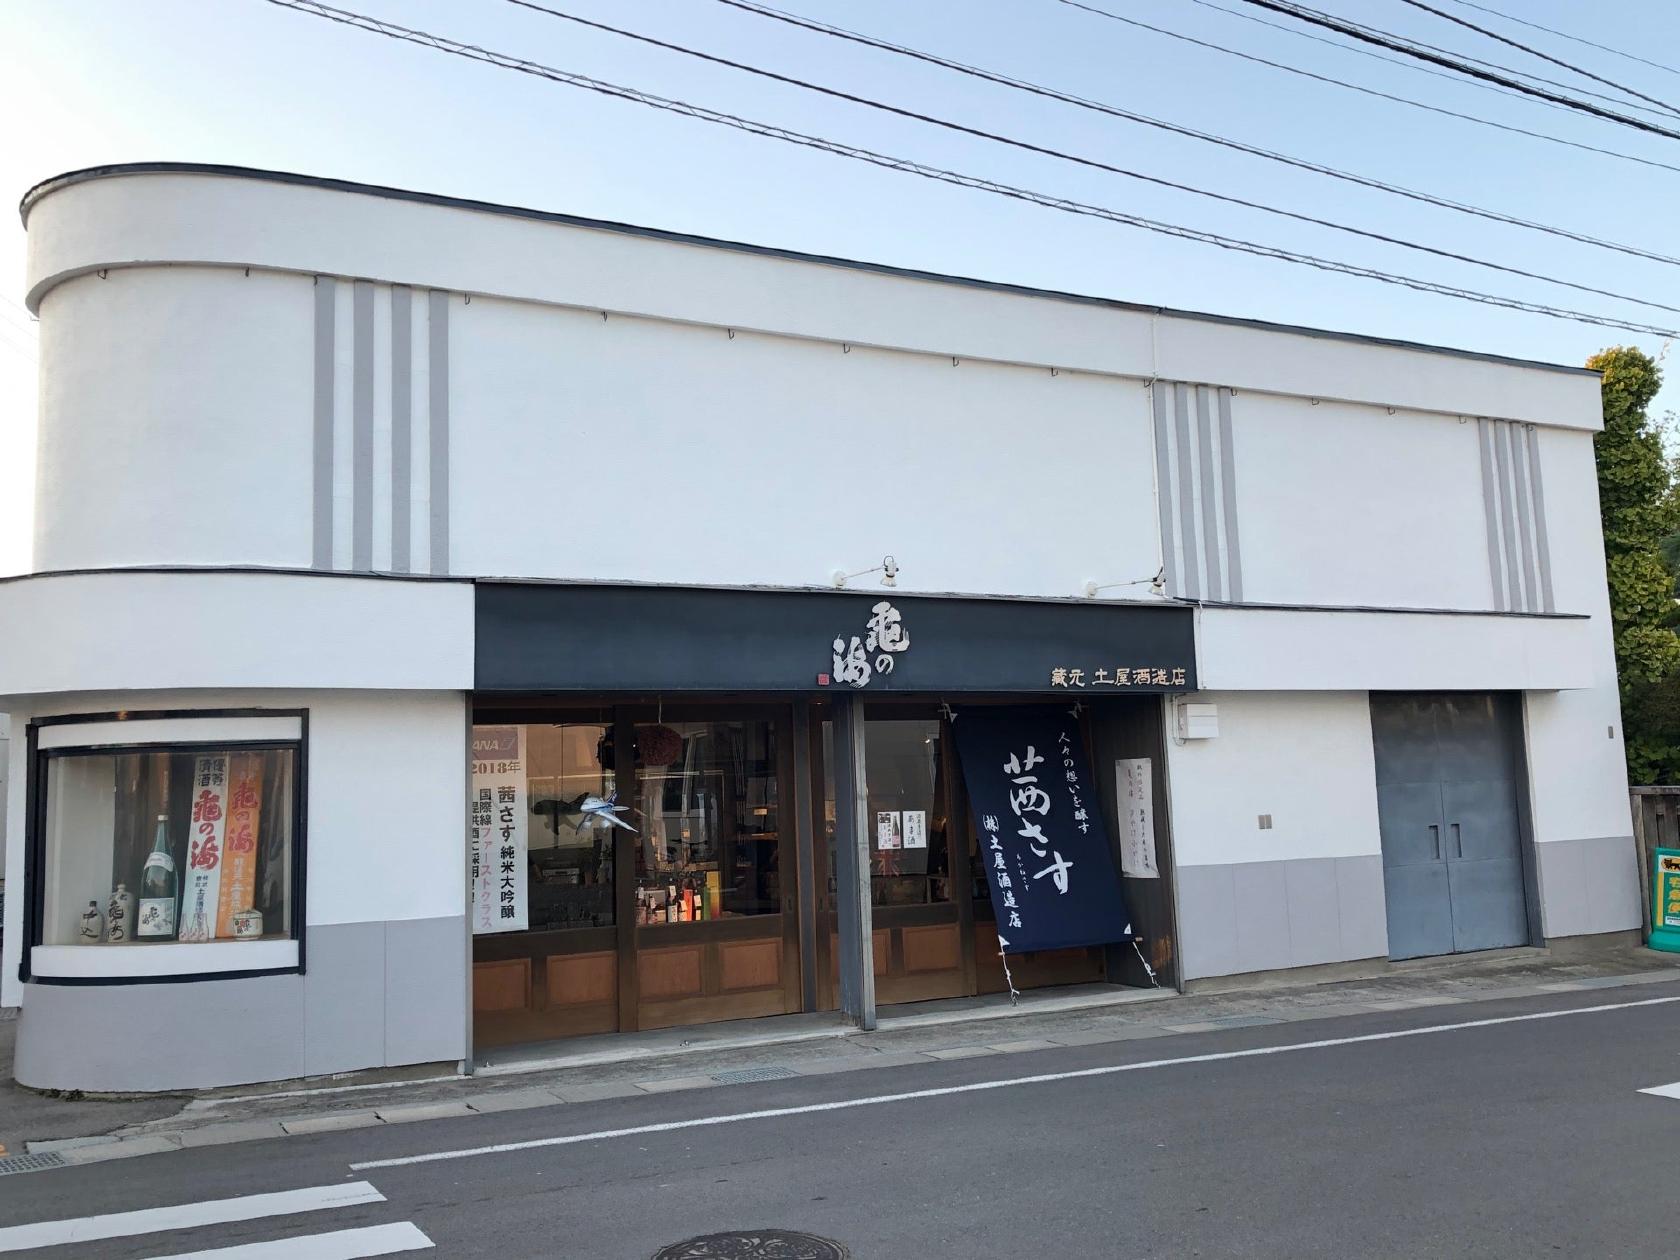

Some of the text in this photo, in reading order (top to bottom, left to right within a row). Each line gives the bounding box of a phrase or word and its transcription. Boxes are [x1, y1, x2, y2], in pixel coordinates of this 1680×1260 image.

[1051, 668, 1186, 688] 蔵元 土屋酒造店
[1003, 745, 1074, 895] 茜さす
